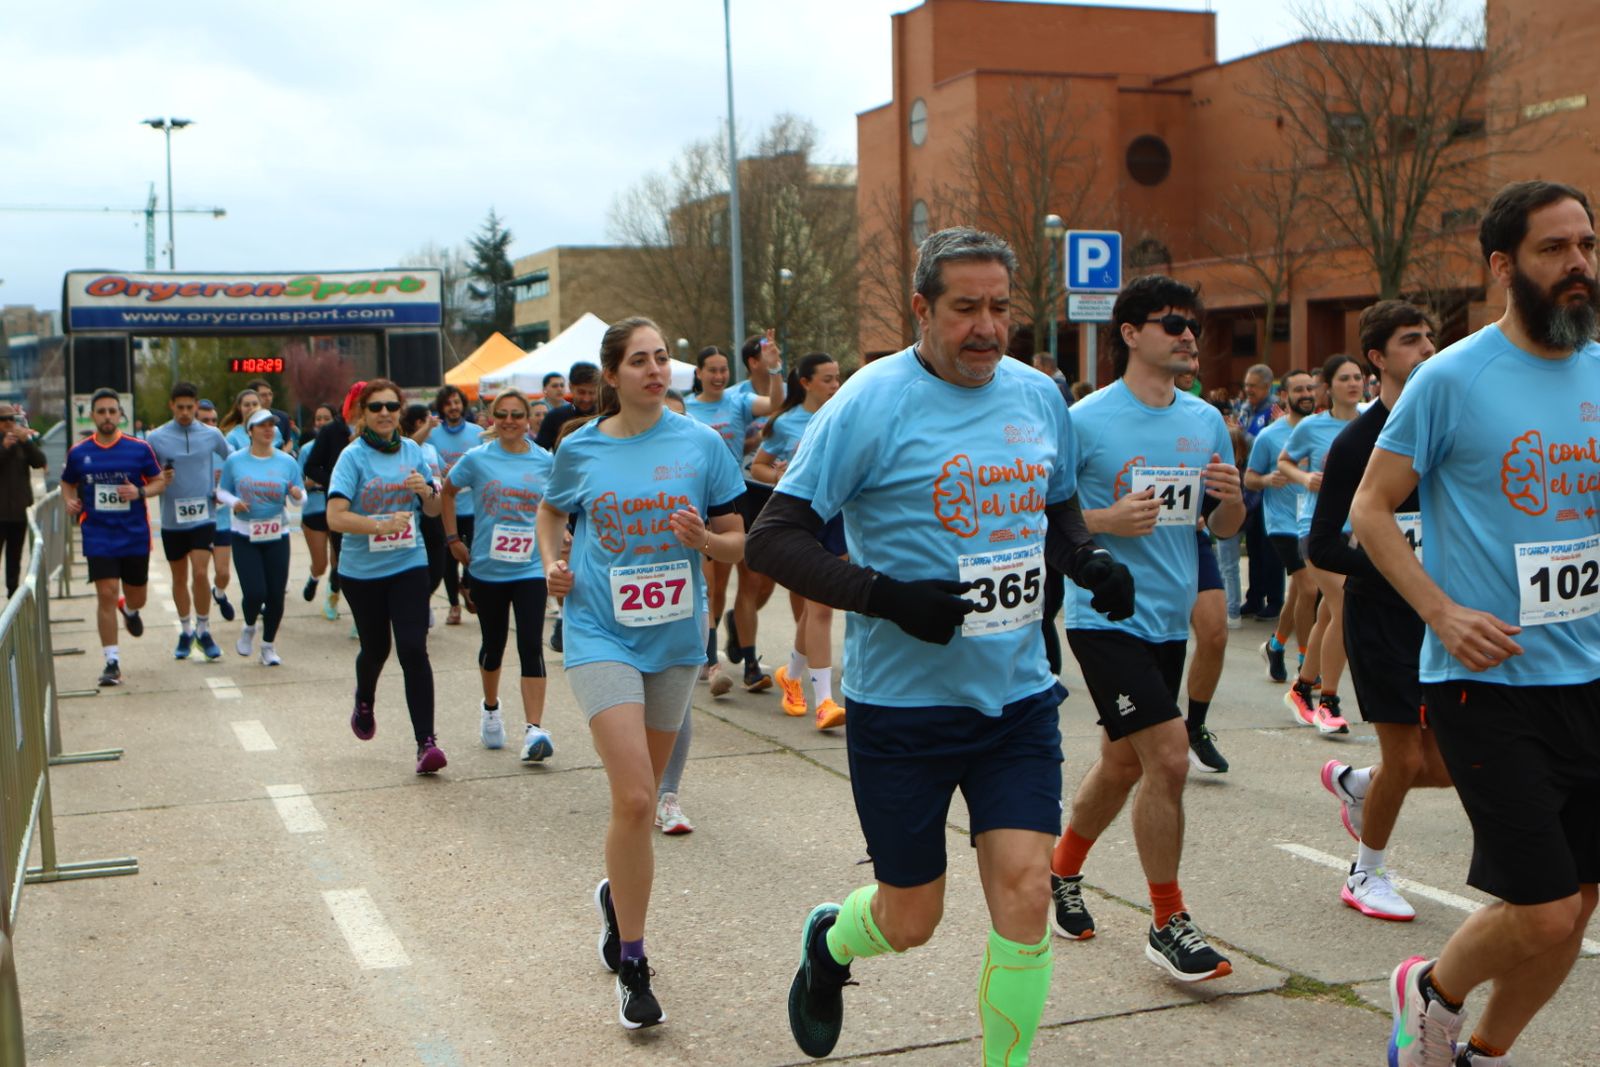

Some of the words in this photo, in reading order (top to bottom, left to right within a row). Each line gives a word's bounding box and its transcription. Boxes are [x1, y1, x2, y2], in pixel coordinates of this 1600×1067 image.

[1078, 237, 1111, 283] P
[122, 308, 395, 323] www.orycronsport.com
[1549, 437, 1600, 465] cont
[1550, 472, 1572, 496] el
[179, 504, 206, 517] 367
[622, 491, 690, 515] contra
[981, 493, 1005, 517] el
[1009, 486, 1046, 514] ictu
[253, 522, 280, 536] 270
[627, 519, 648, 536] el
[495, 535, 532, 553] 227
[971, 567, 1040, 613] 365
[1530, 560, 1599, 602] 102
[619, 578, 686, 611] 267
